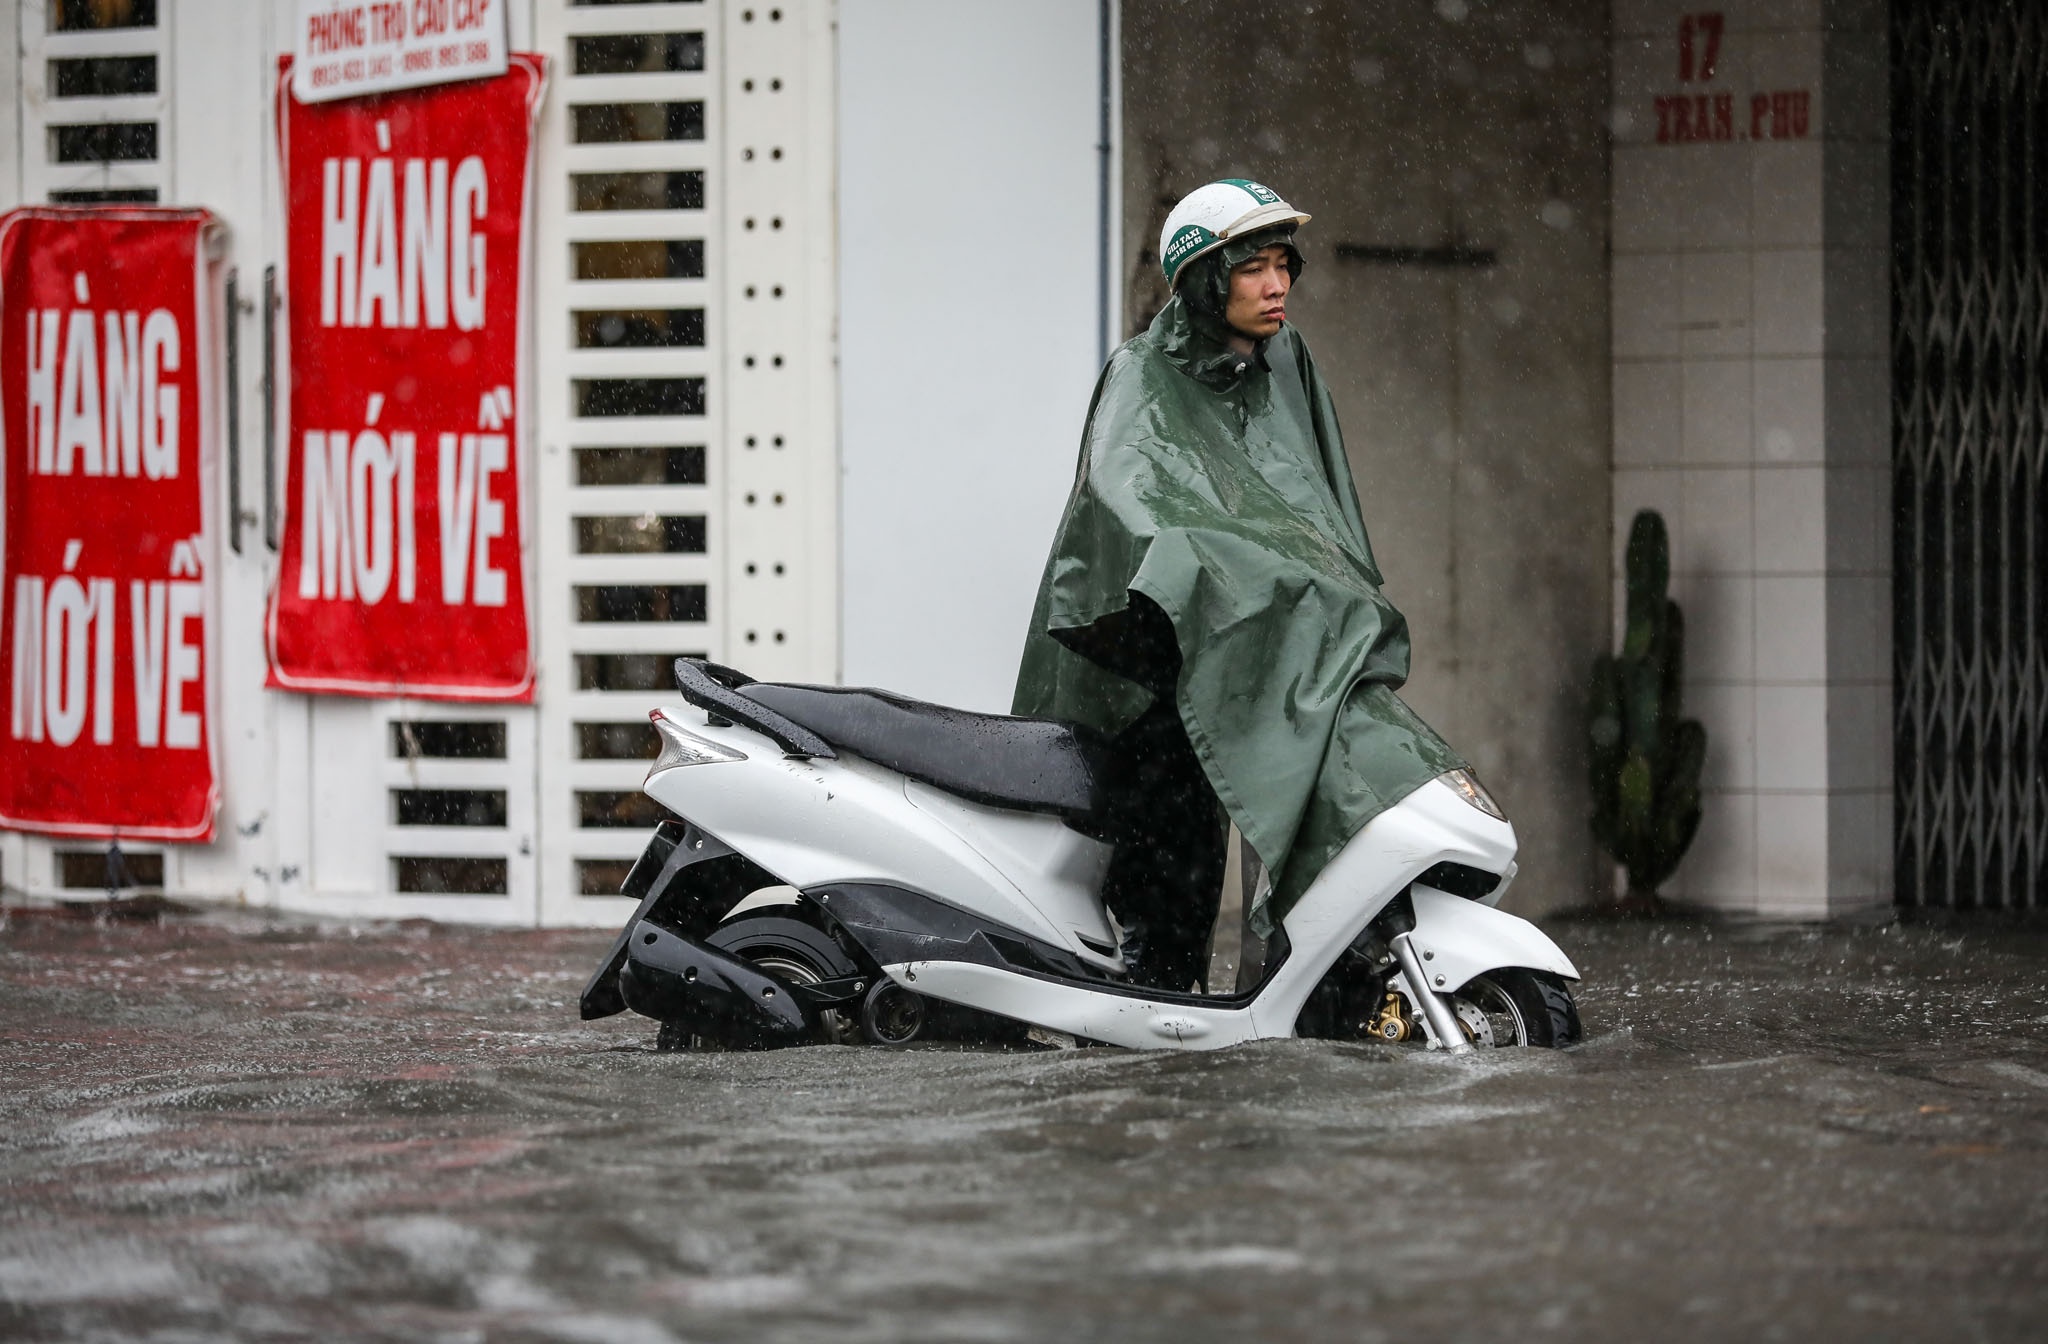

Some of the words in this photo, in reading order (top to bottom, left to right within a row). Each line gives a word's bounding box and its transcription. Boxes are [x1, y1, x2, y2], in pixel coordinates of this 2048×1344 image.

[1678, 13, 1724, 81] 17
[321, 119, 488, 333] HÀNG
[1179, 227, 1201, 245] TAXI
[26, 270, 181, 481] HÀNG
[299, 392, 416, 606] MỚI
[438, 384, 513, 607] VỀ
[130, 533, 205, 750] VỀ
